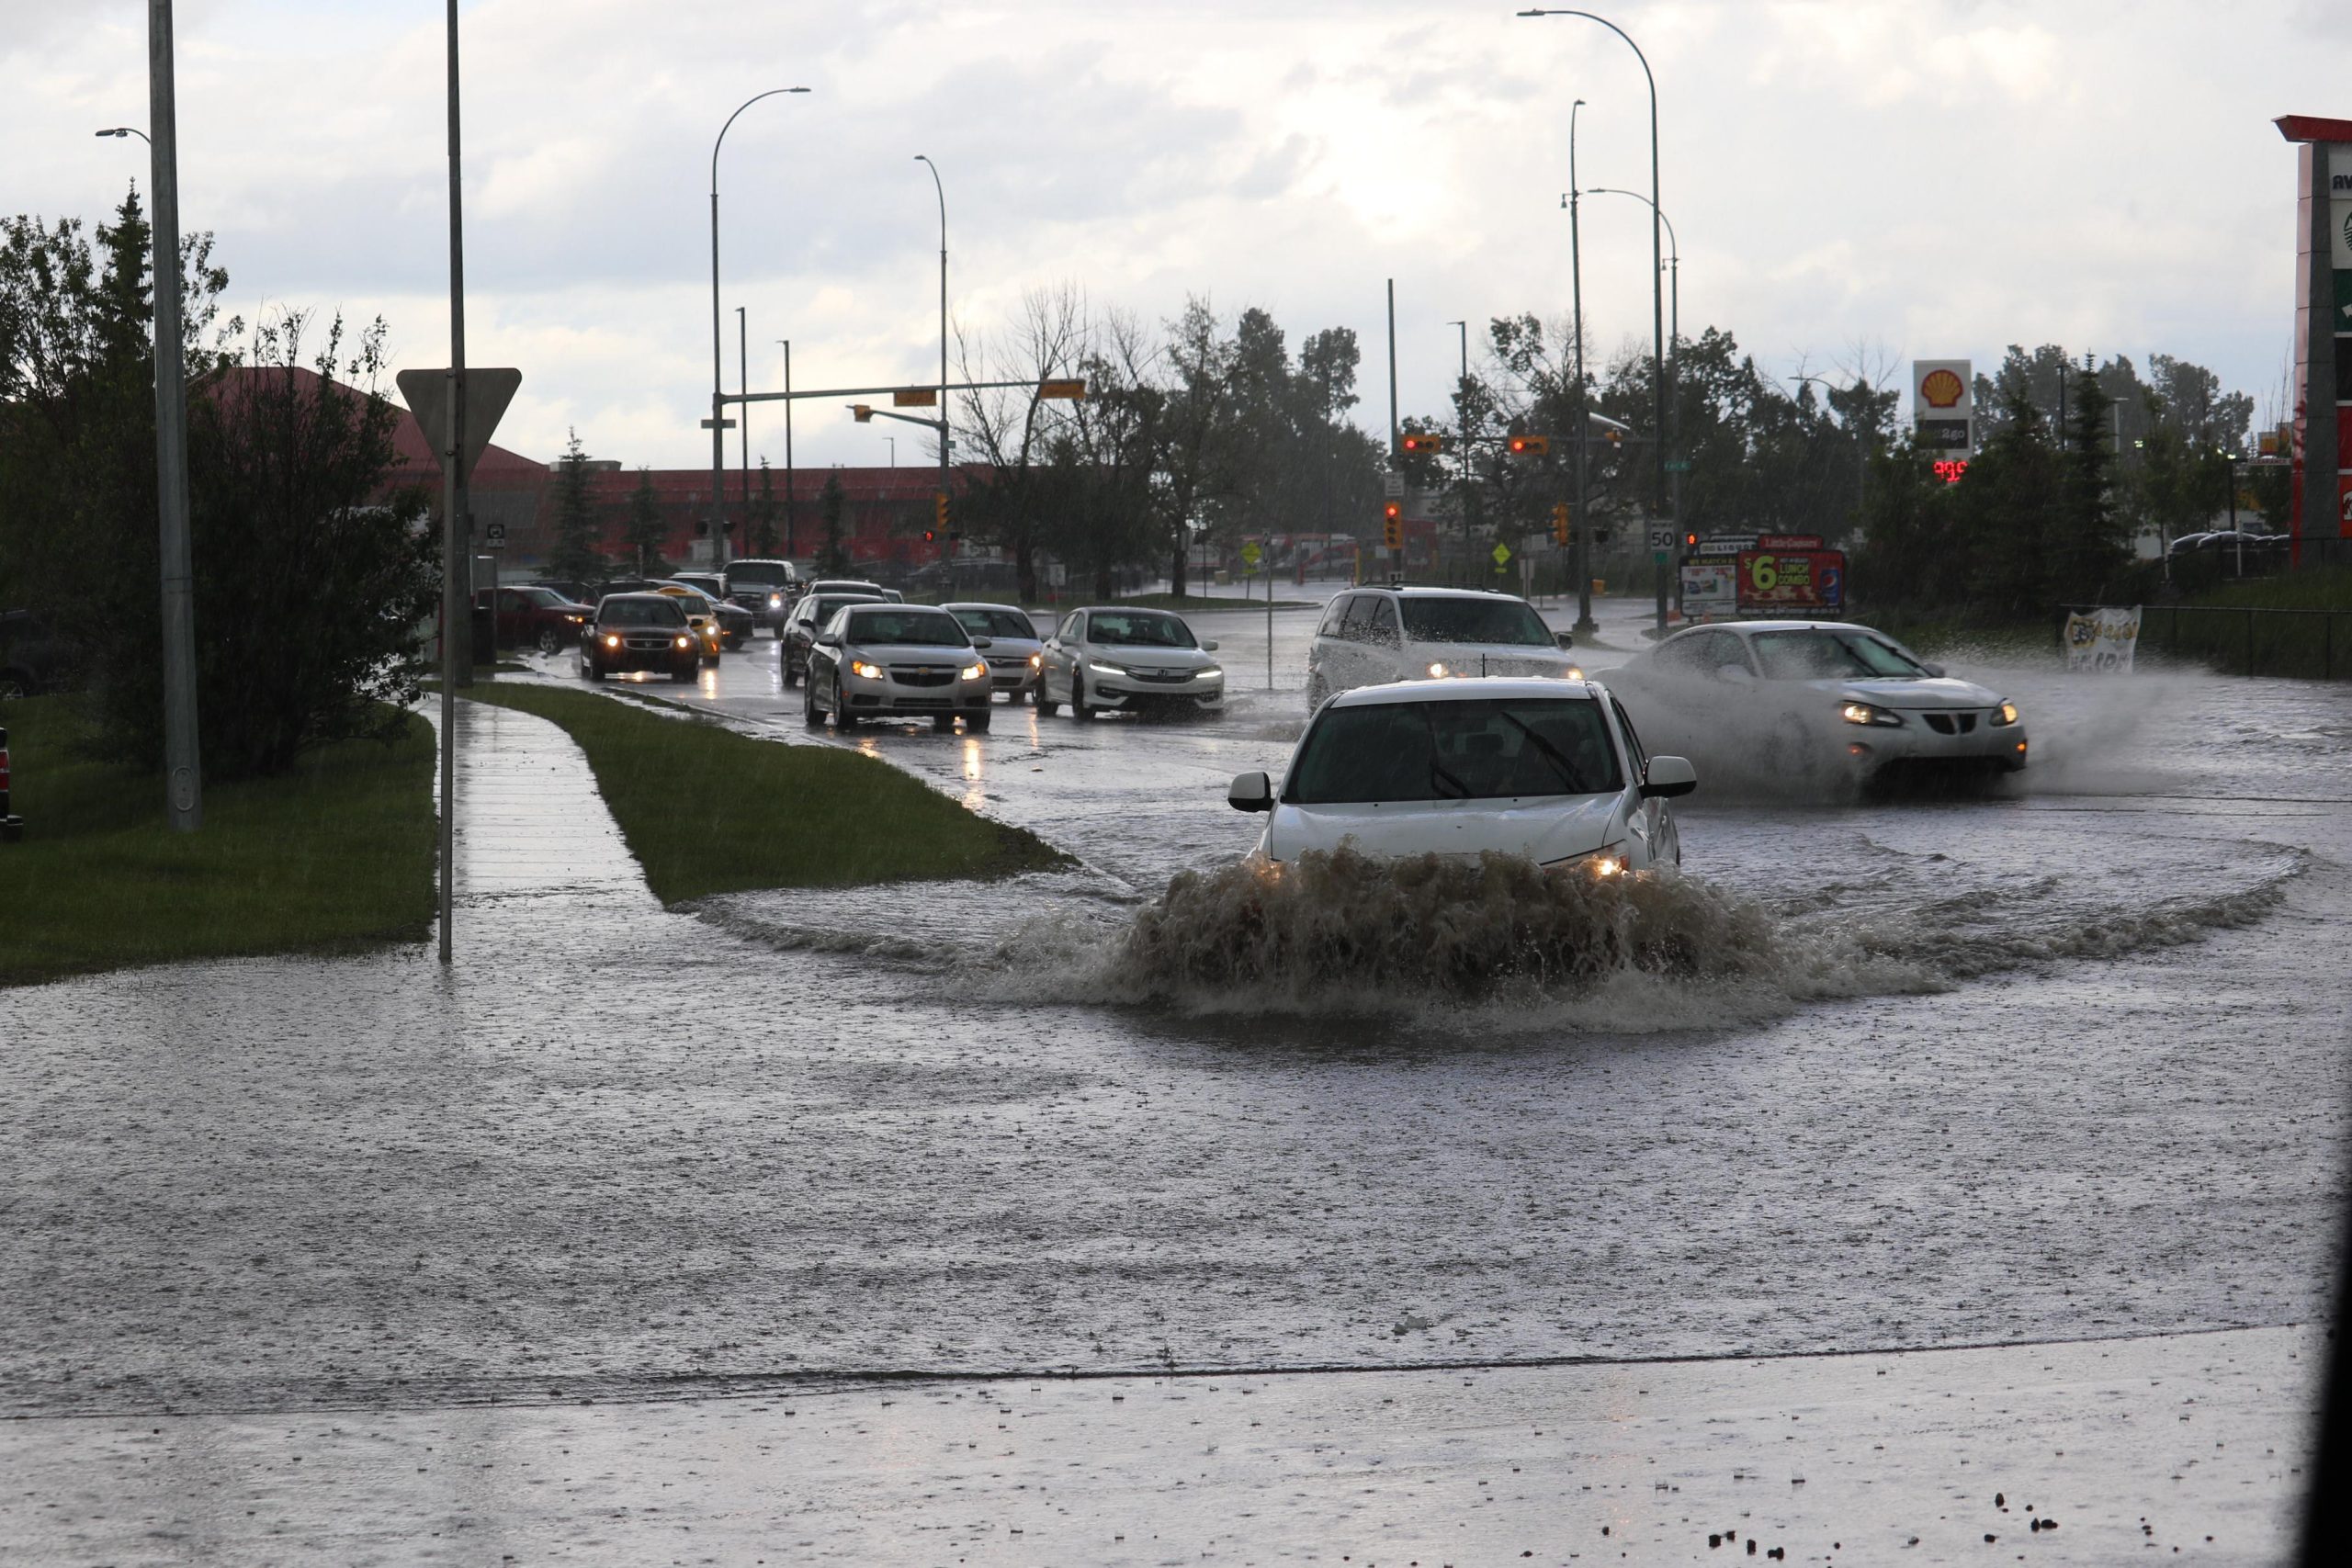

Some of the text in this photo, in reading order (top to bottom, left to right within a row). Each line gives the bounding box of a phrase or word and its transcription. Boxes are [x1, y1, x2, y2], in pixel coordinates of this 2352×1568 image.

[1652, 531, 1673, 547] 50
[1744, 555, 1777, 591] $6
[1780, 563, 1808, 574] LUNCH
[1778, 575, 1810, 585] COMBO
